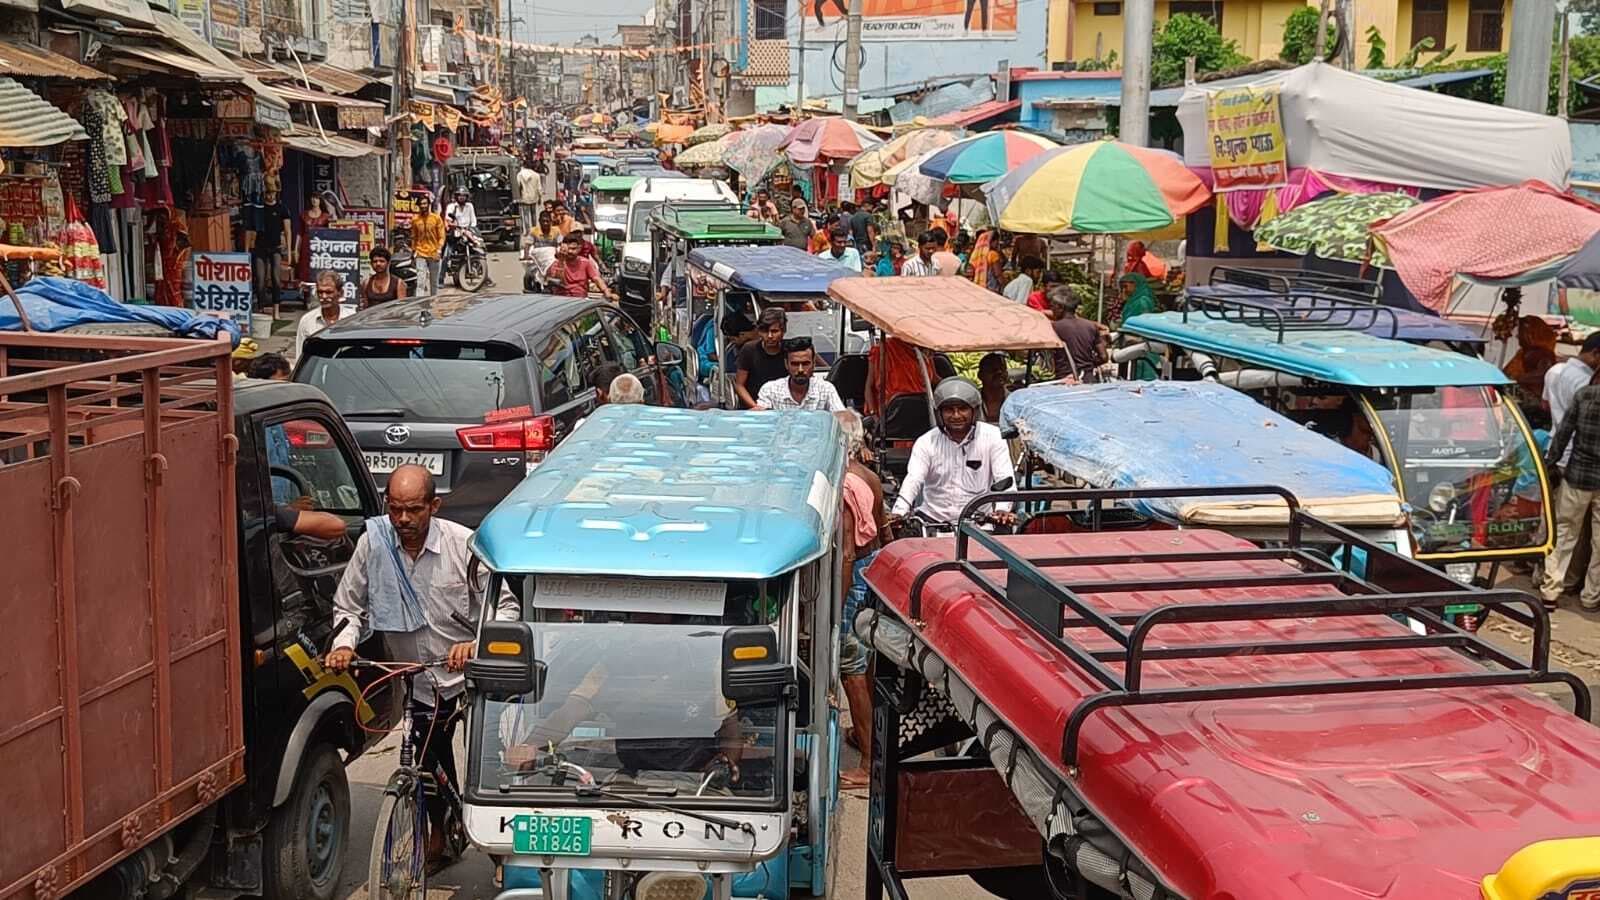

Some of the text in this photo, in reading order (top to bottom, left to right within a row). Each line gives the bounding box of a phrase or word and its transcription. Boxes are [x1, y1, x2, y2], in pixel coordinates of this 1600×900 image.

[1250, 132, 1274, 153] प्याऊ
[309, 236, 358, 253] नेशनल
[195, 254, 251, 282] पोशाक
[309, 252, 358, 270] मेडिकल
[194, 284, 251, 312] रेडिमेड
[528, 816, 583, 834] BR50E
[528, 834, 583, 852] R1846
